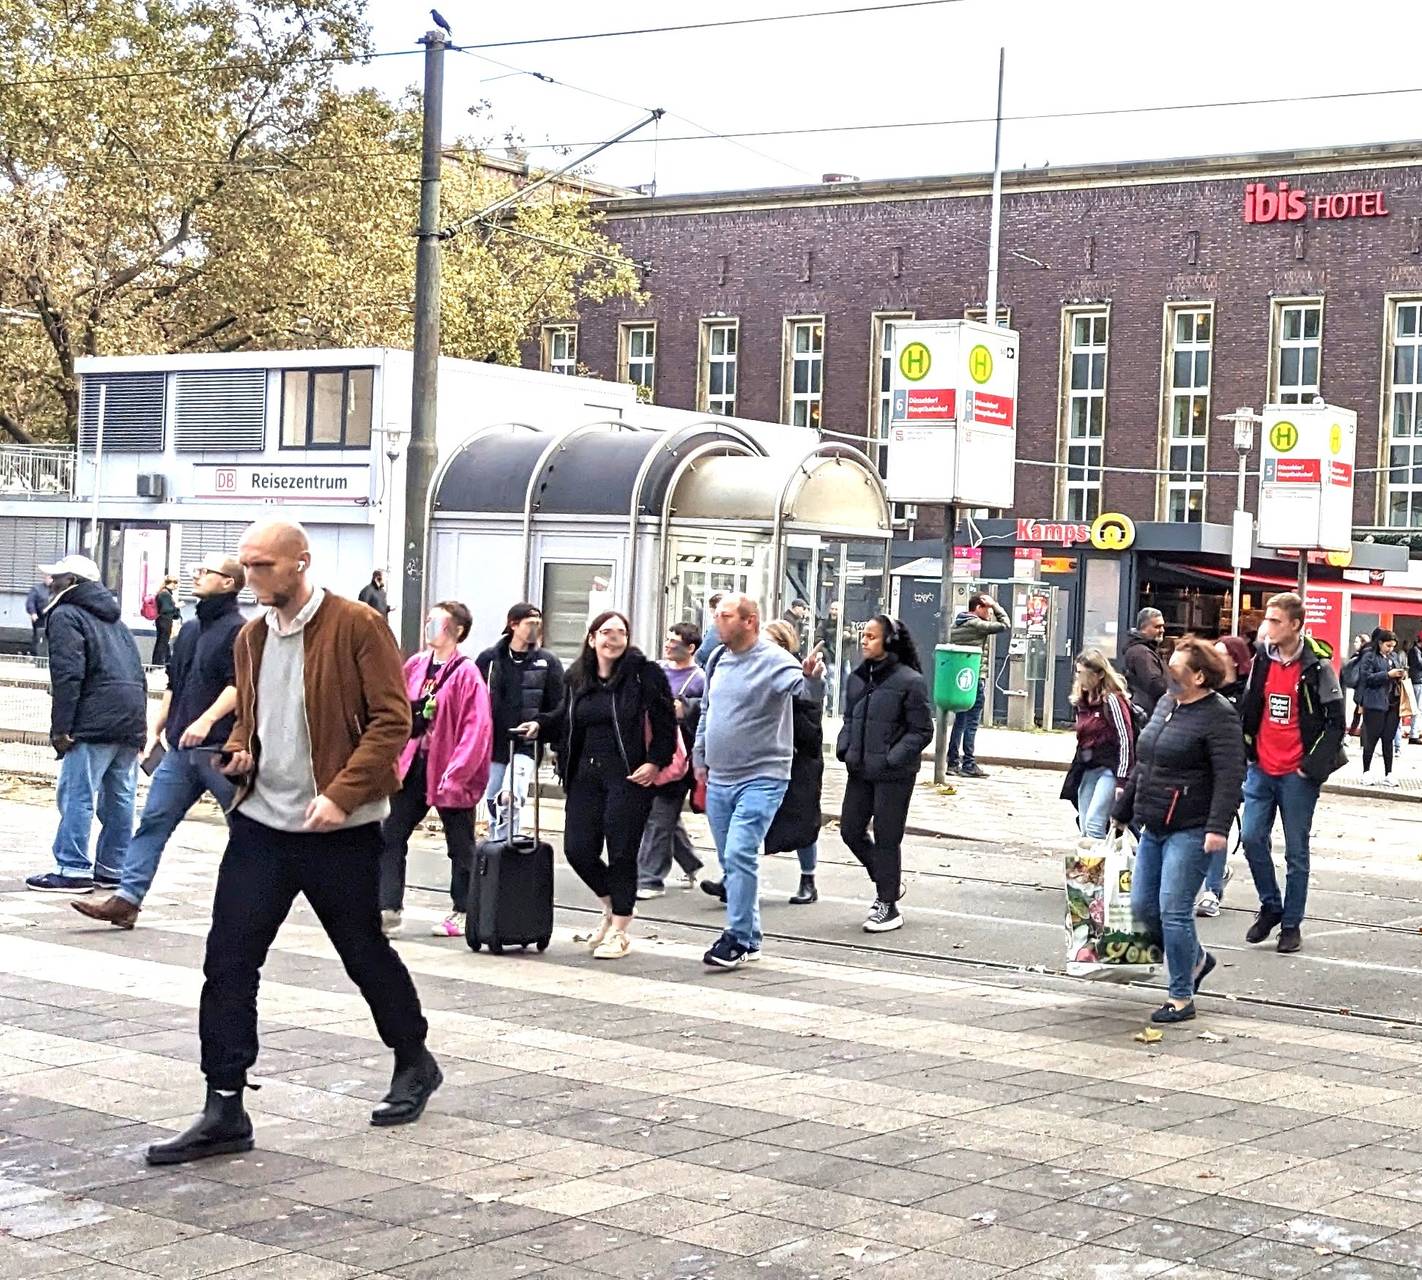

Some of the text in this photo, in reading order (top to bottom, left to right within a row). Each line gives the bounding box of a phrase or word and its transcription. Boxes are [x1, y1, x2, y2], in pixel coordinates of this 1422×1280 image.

[1244, 181, 1389, 223] ibis HOTEL
[896, 399, 905, 411] 6
[1266, 465, 1273, 475] 5
[217, 472, 348, 490] DB Reisezentrum
[1016, 518, 1090, 547] Kamps
